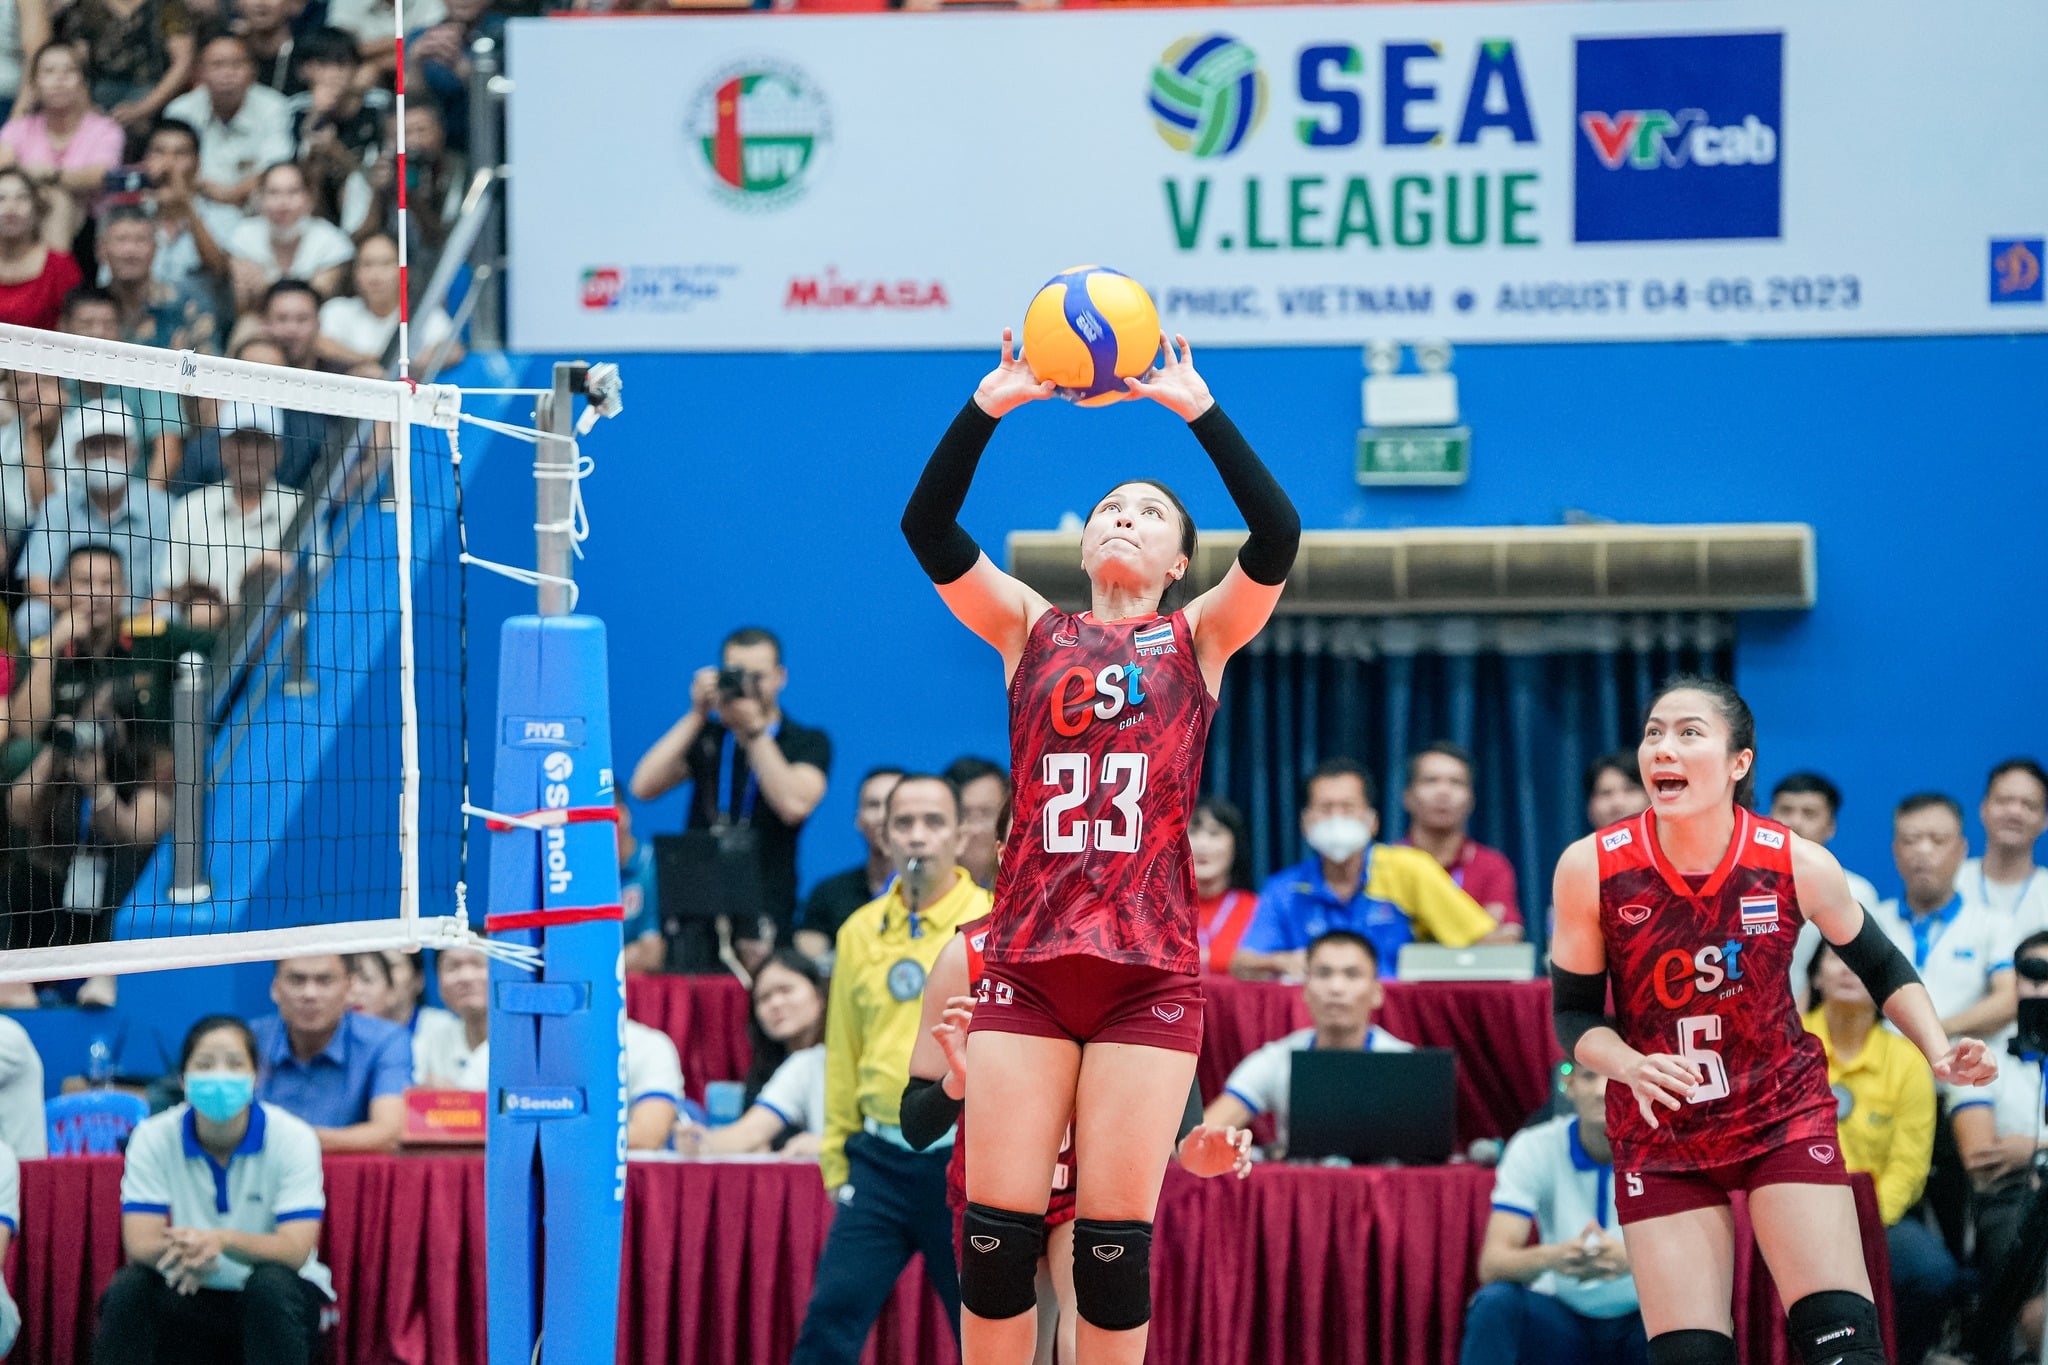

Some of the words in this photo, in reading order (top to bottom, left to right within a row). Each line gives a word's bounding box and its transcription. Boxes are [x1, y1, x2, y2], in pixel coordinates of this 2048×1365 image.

[1296, 40, 1538, 147] SEA
[1580, 108, 1777, 170] VTVcab
[1163, 173, 1541, 250] V.LEAGUE
[1277, 283, 1433, 315] VIETNAM
[1496, 279, 1629, 315] AUGUST
[1136, 644, 1178, 657] THA
[1050, 660, 1146, 737] est
[524, 722, 565, 740] FIVB
[1119, 711, 1145, 731] COLA
[1042, 752, 1149, 854] 23
[545, 783, 573, 894] Snoh
[1605, 832, 1631, 848] PEA
[1756, 831, 1780, 845] PEA
[1742, 922, 1780, 936] THA
[1653, 938, 1745, 1010] est
[1719, 984, 1744, 1001] COLA
[519, 1097, 575, 1110] Senoh
